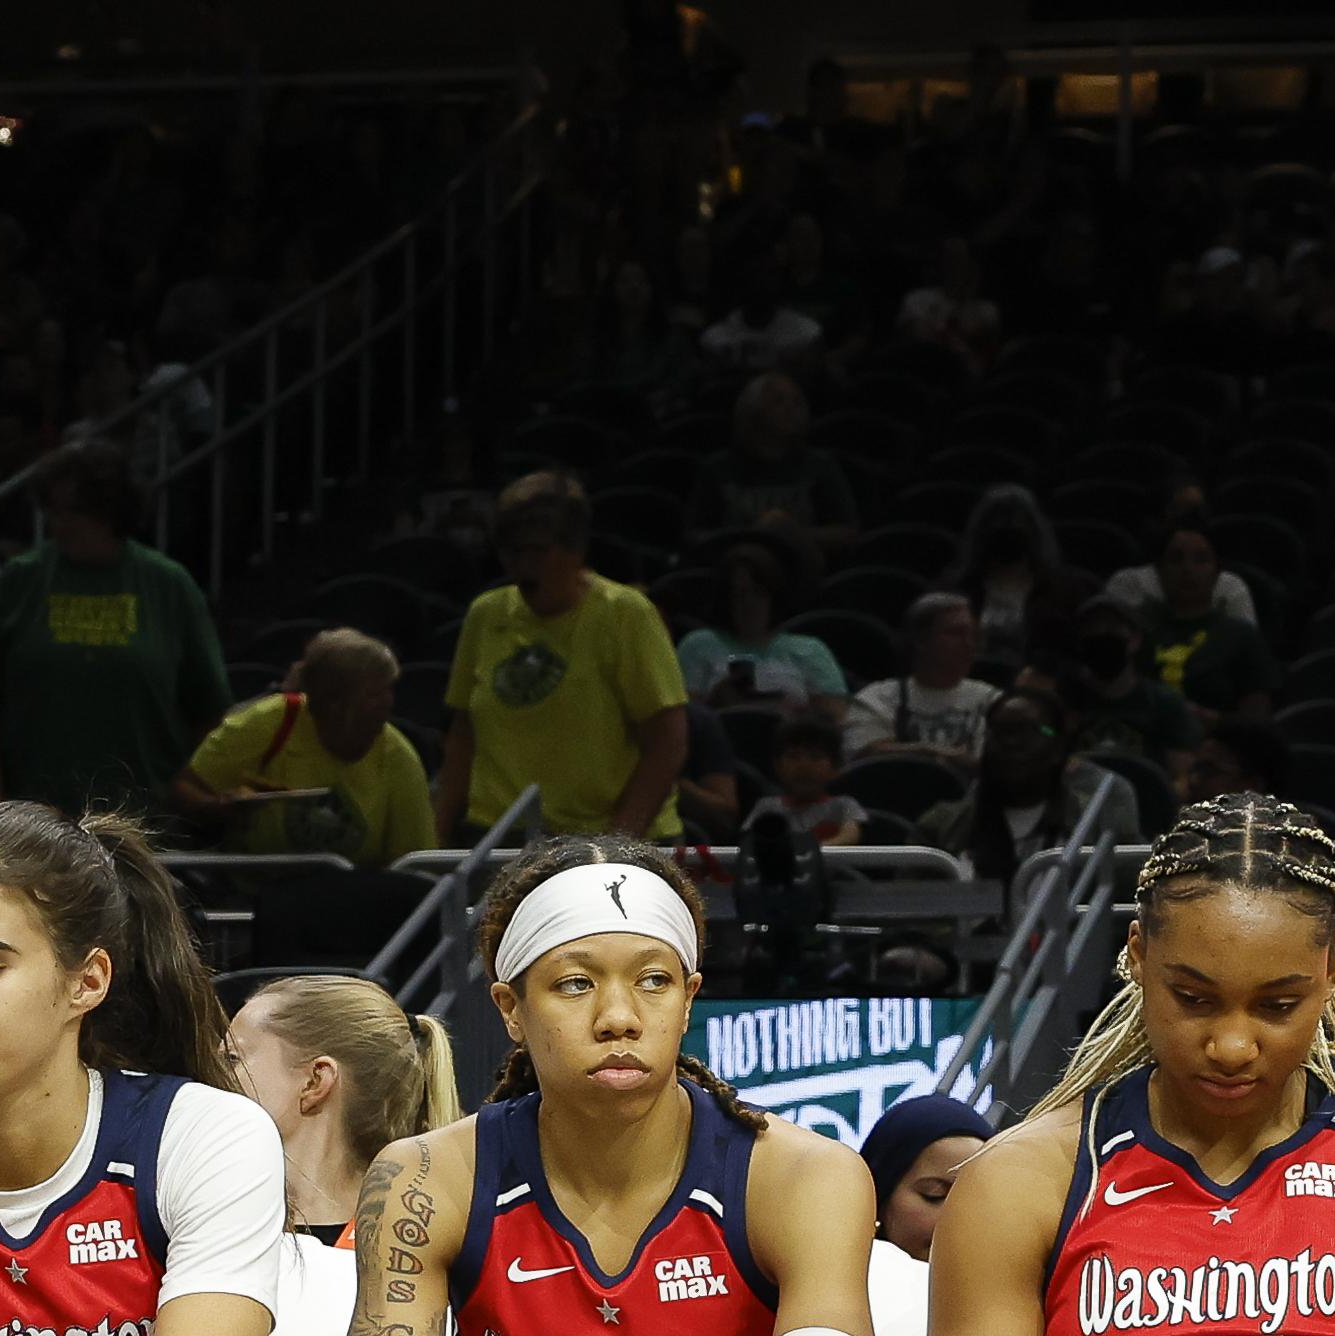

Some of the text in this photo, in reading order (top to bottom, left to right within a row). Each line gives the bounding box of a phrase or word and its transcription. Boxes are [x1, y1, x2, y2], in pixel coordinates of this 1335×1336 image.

[706, 997, 932, 1080] NOTHING BUT
[66, 1220, 122, 1244] CAR
[69, 1239, 138, 1264] max
[654, 1255, 711, 1281] CAR
[658, 1274, 729, 1302] max
